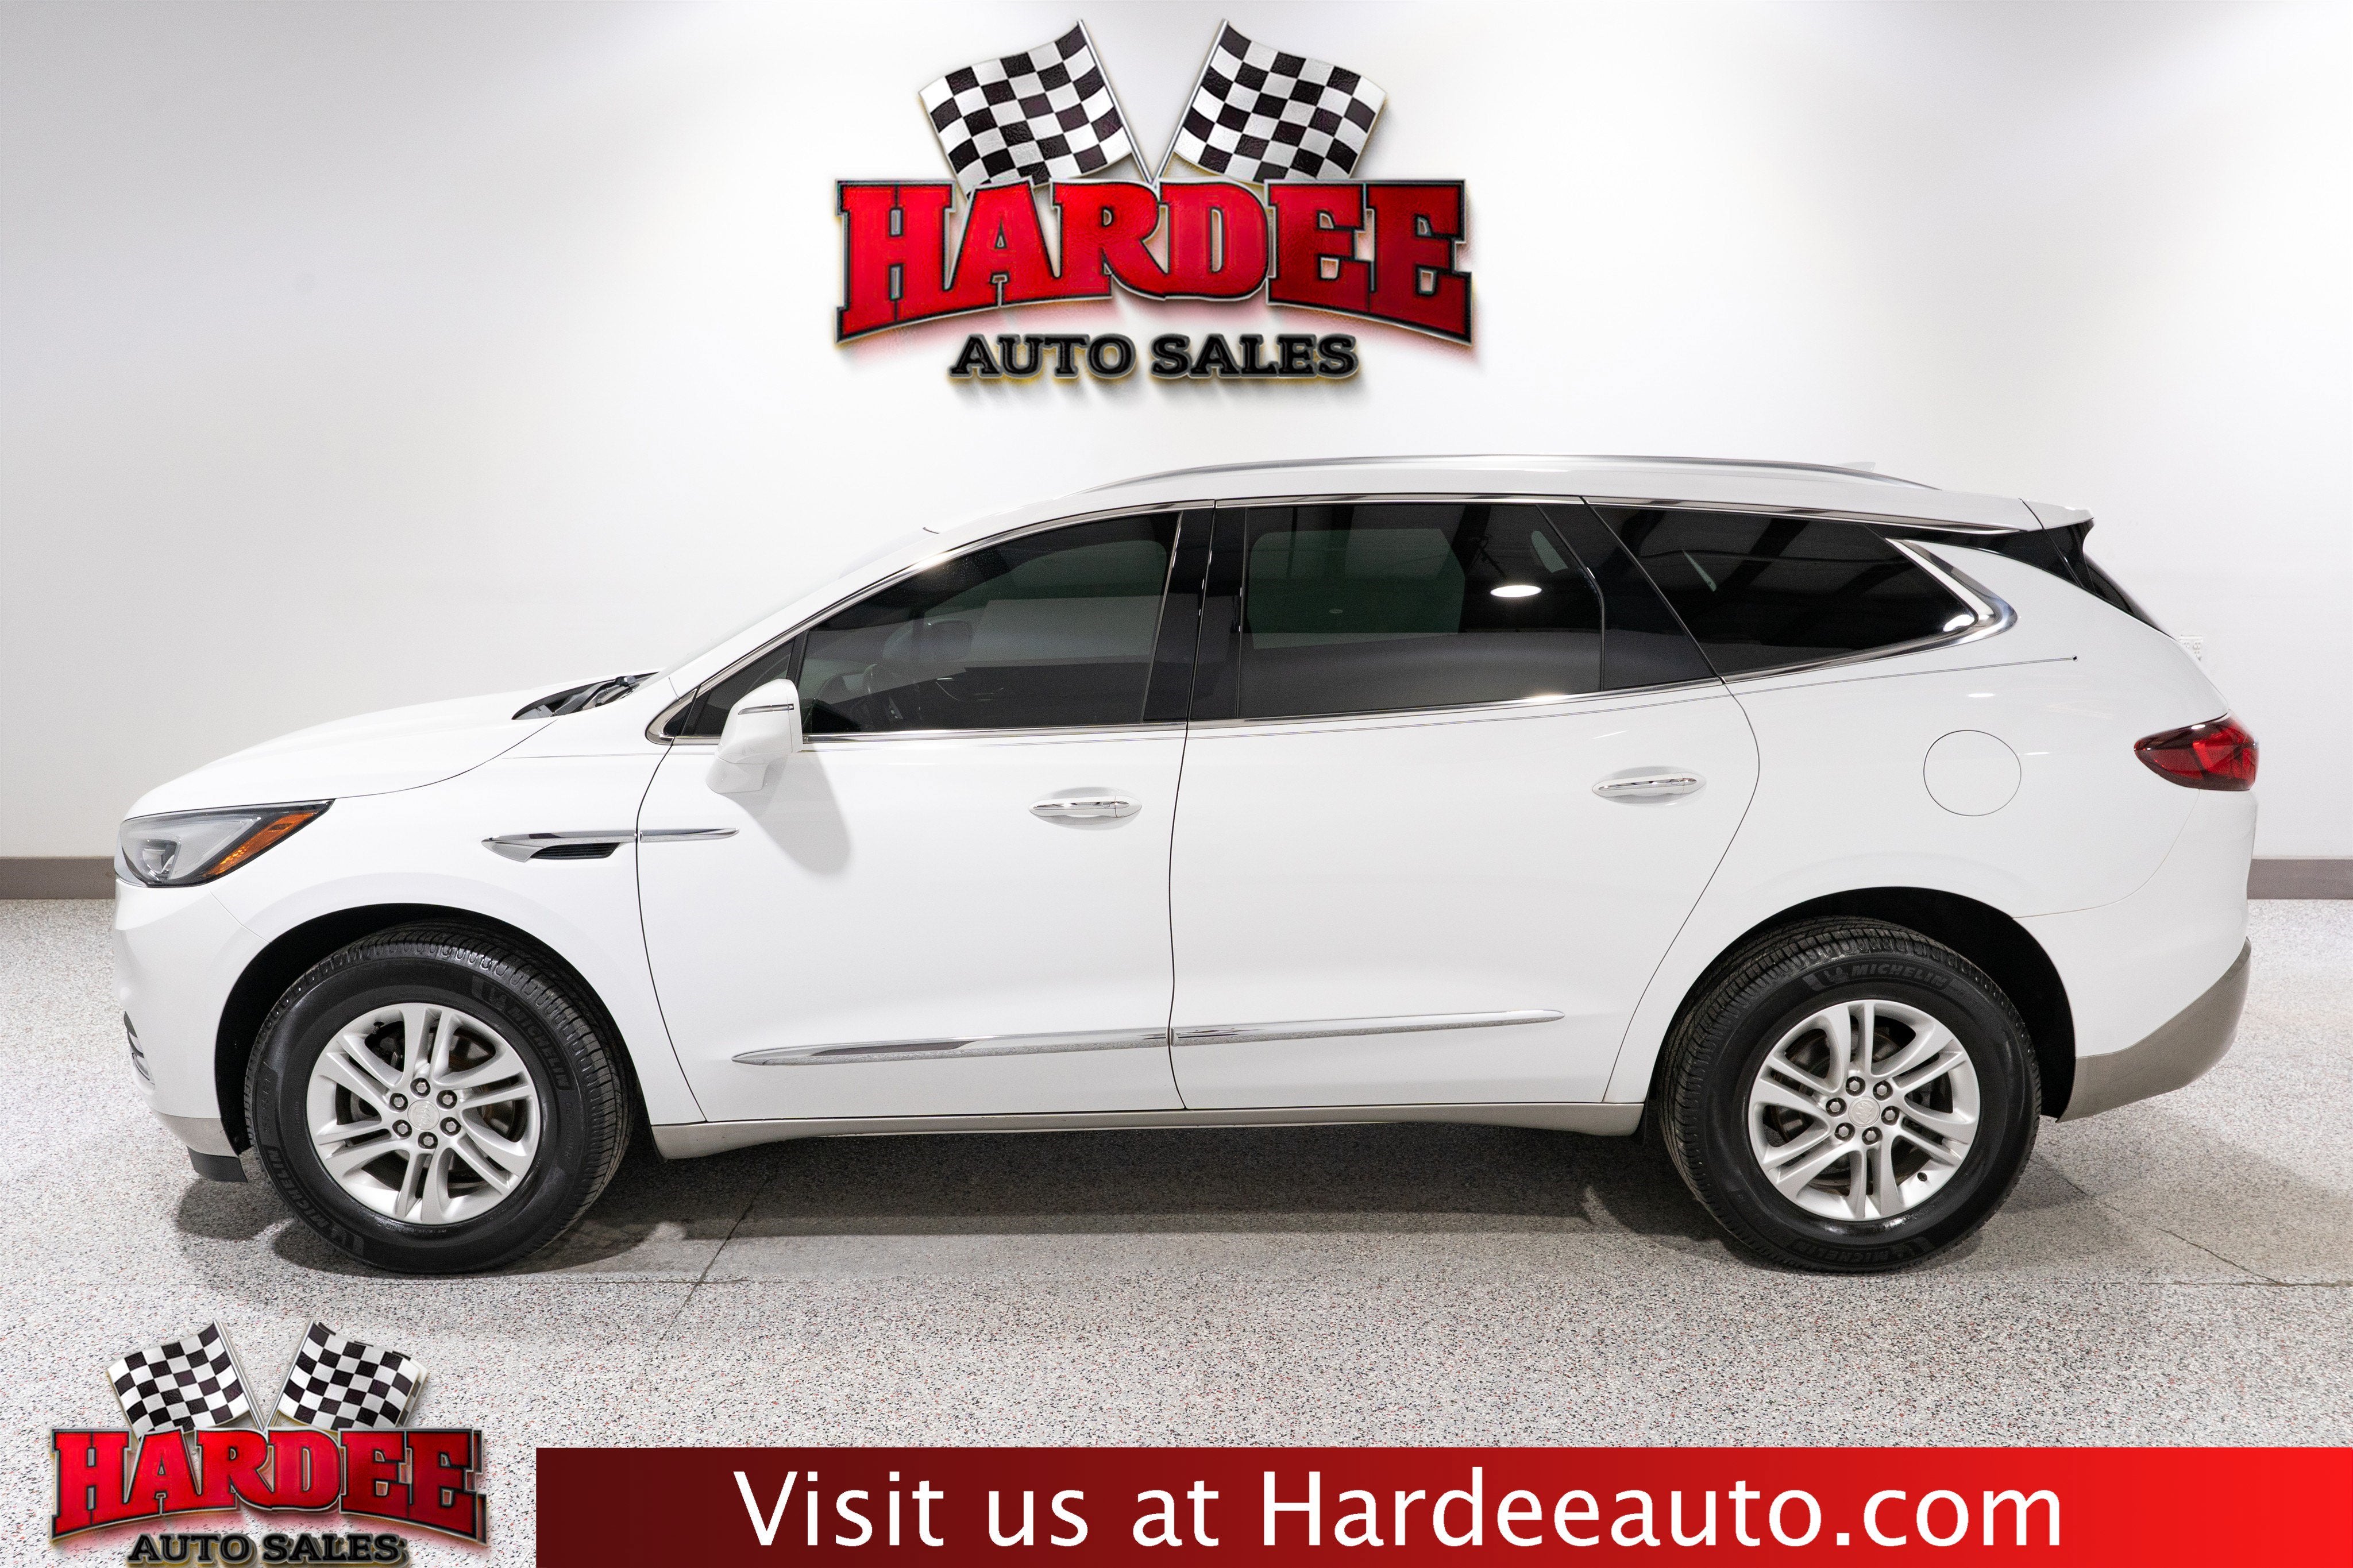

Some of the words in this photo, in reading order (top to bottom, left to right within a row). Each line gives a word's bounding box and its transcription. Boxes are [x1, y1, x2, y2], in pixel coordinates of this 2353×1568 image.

[835, 179, 1472, 343] HARDEE
[948, 333, 1136, 379] AUTO
[1150, 333, 1359, 379] SALES
[1851, 963, 1947, 987] MICHELIN
[507, 1006, 569, 1087] MICHELIN
[268, 1149, 330, 1228] MICHELIN
[1793, 1241, 1889, 1263] MICHELIN
